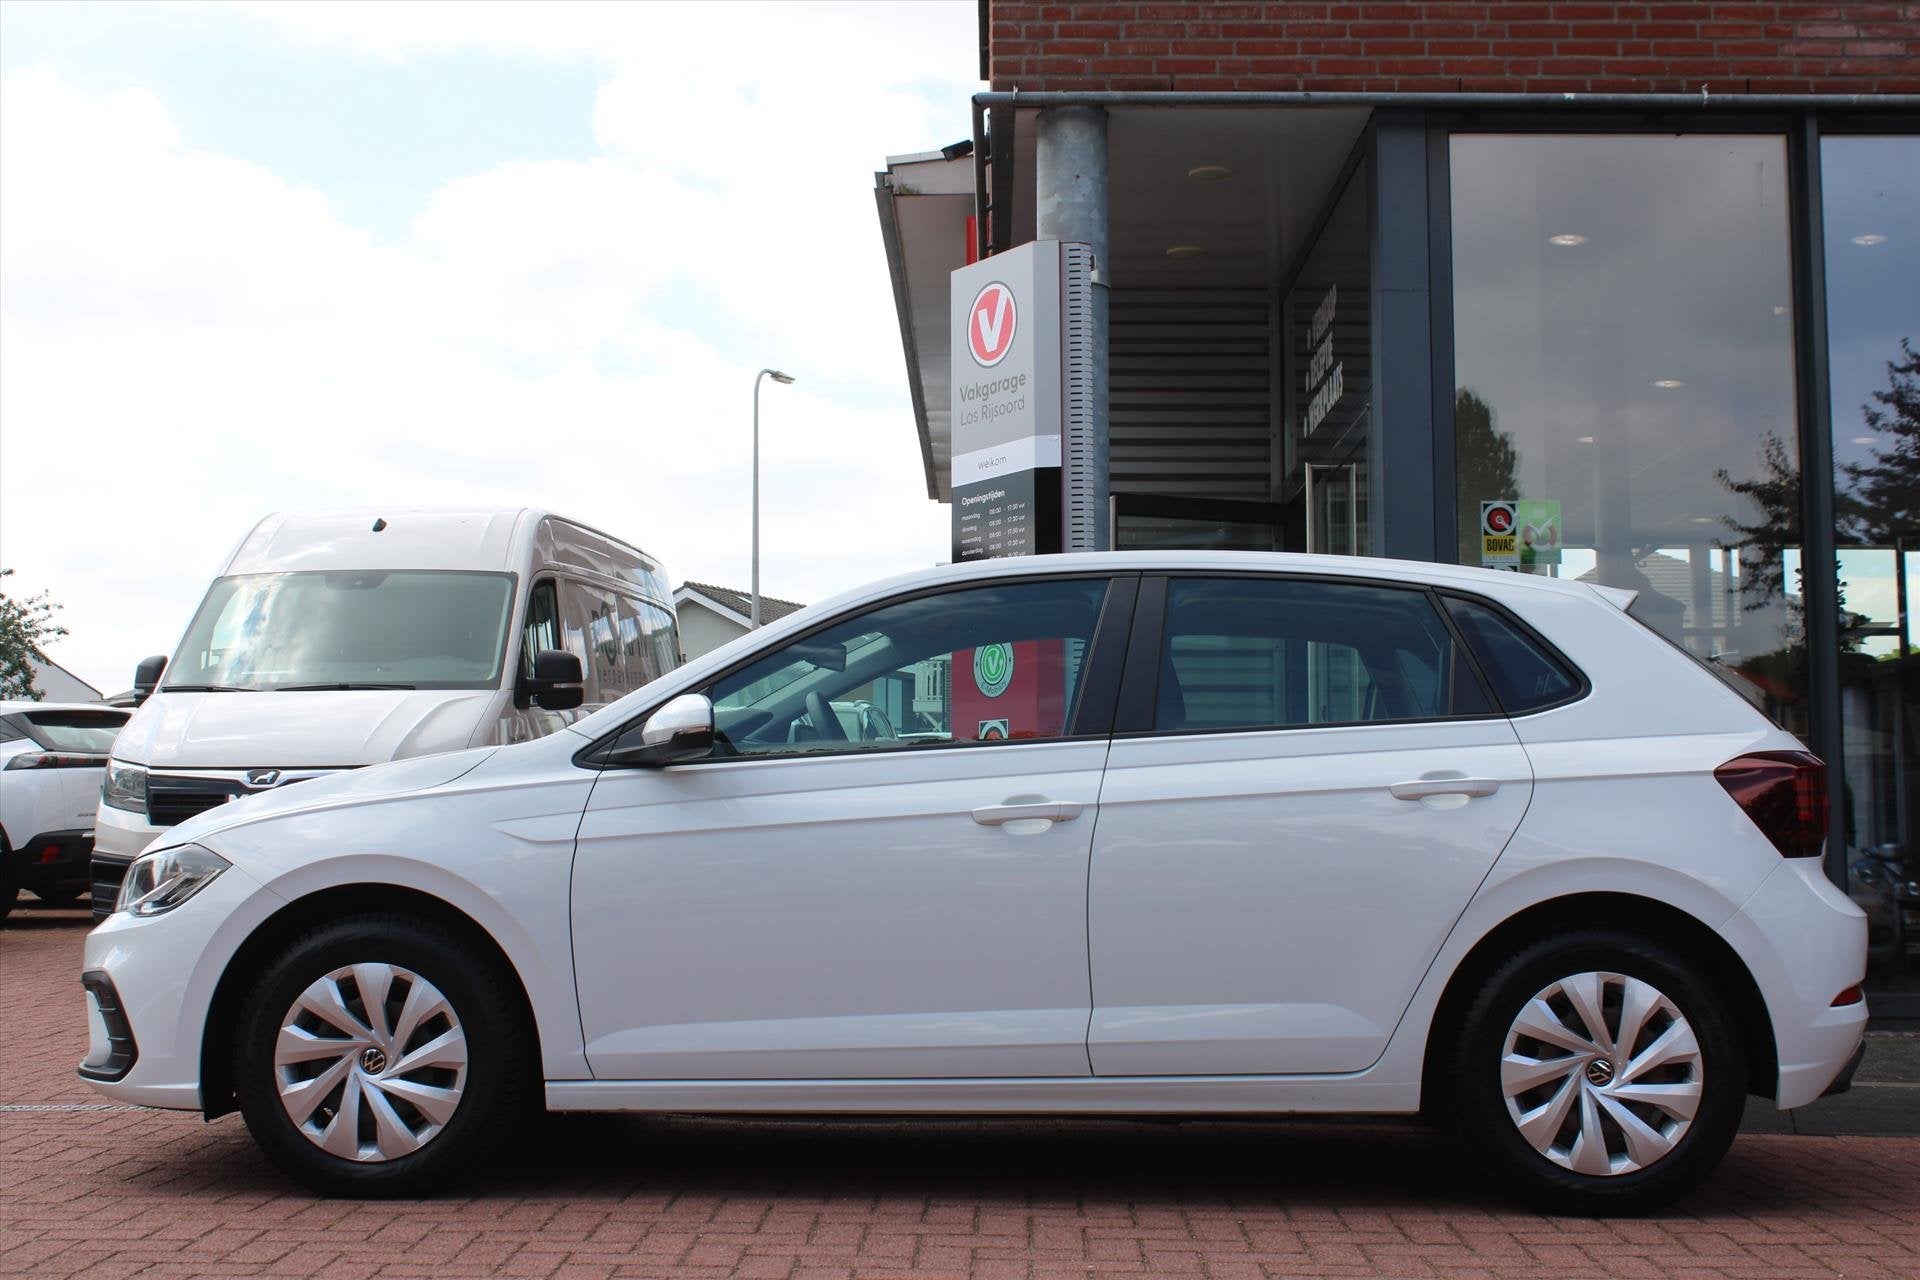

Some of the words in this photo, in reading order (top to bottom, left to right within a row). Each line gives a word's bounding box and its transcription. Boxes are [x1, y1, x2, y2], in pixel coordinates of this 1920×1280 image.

[960, 373, 1026, 402] Vakgarage
[960, 410, 978, 426] Los
[981, 395, 1025, 423] Rijsoord
[977, 455, 1007, 470] welkom
[961, 490, 1005, 506] Openingstijden
